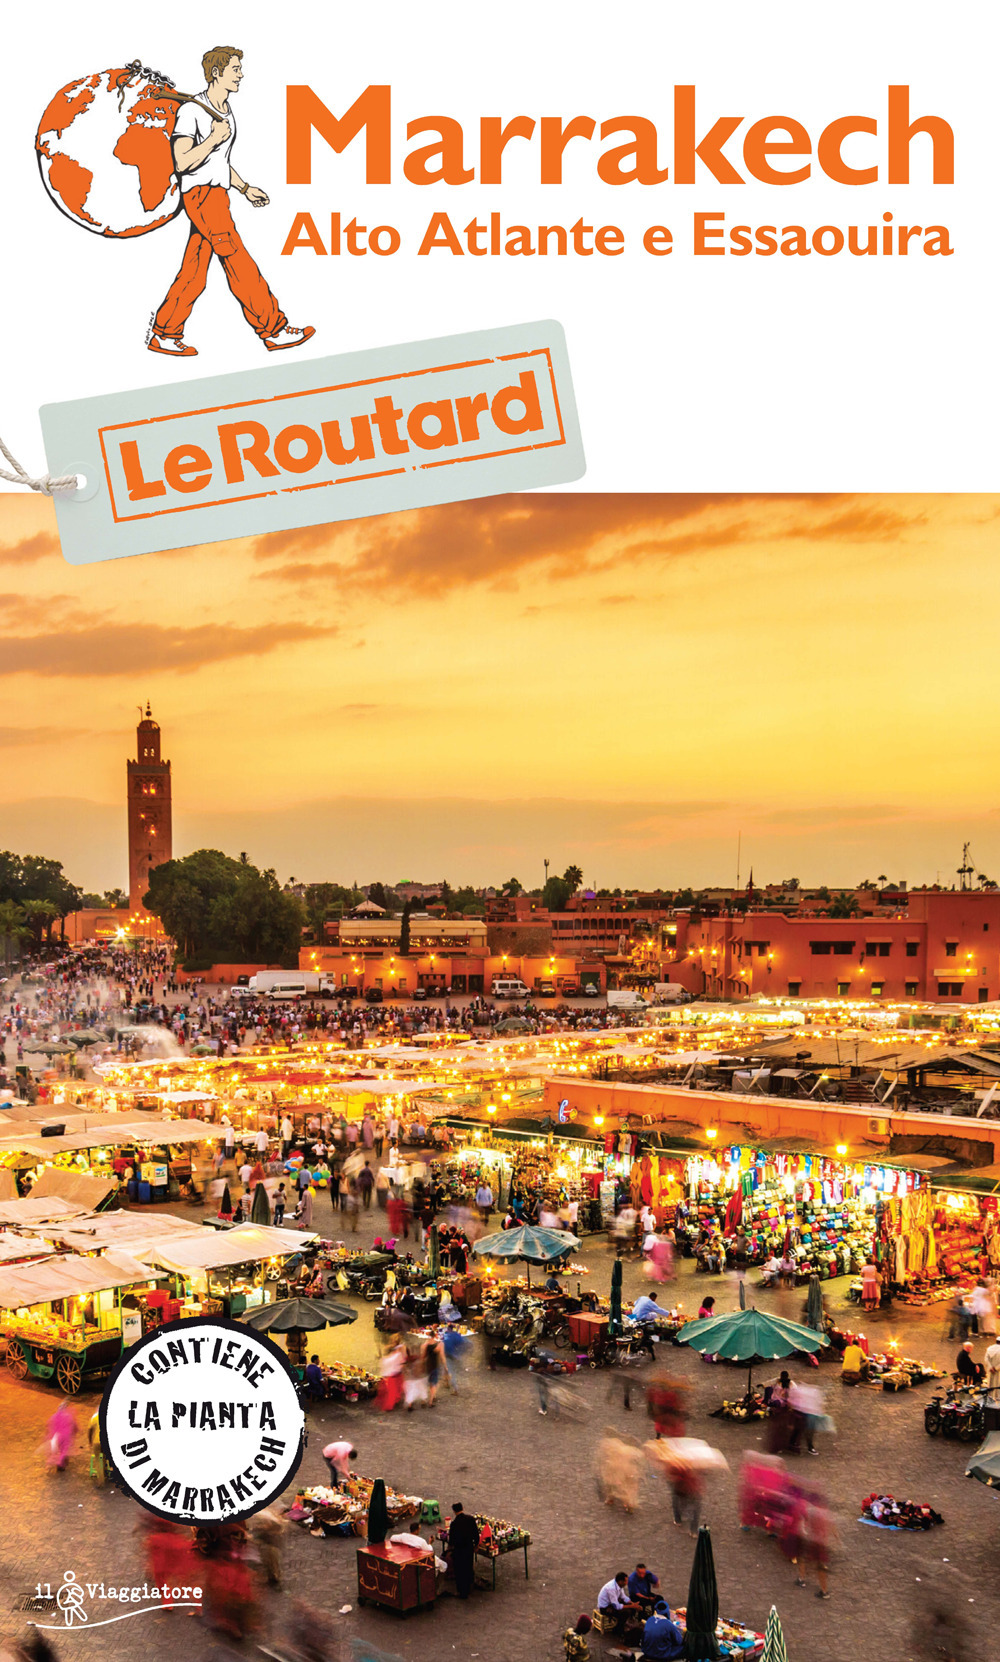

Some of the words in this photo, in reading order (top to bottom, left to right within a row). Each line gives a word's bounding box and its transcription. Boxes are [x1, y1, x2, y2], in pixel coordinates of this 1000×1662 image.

[286, 84, 955, 186] Marrakech
[281, 212, 401, 257] Alto
[418, 212, 625, 257] Atlante
[643, 225, 674, 257] e
[693, 212, 955, 257] Essaouira
[130, 1337, 275, 1389] CONTIENE
[128, 1400, 162, 1431] LA
[172, 1401, 277, 1431] PIANTA
[120, 1437, 152, 1470] DI
[141, 1435, 286, 1513] MARRAKECH
[35, 1582, 54, 1600] il
[85, 1582, 203, 1603] Viaggiatore
